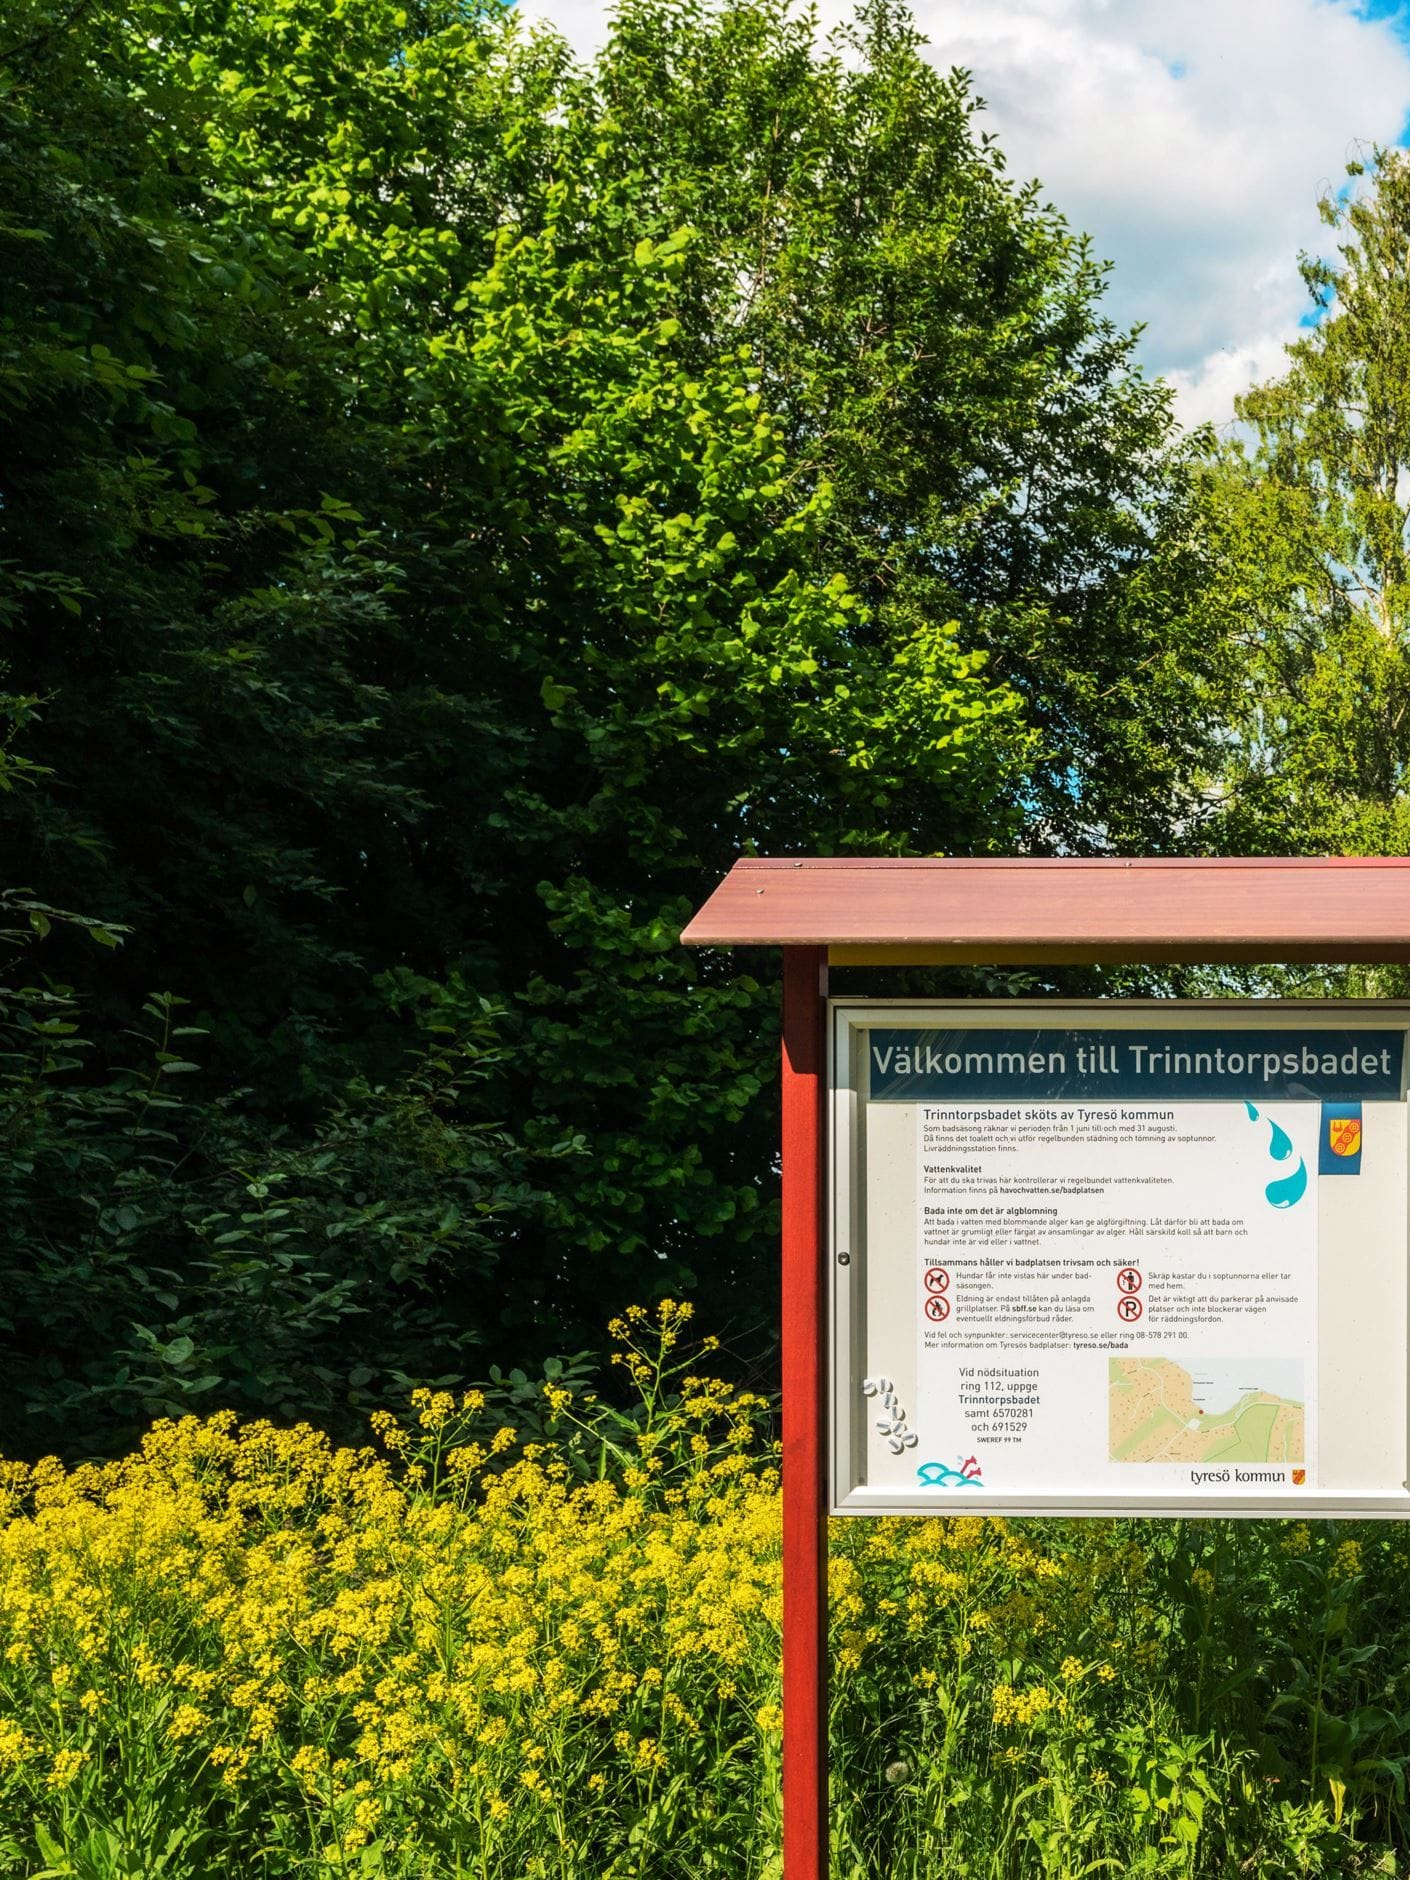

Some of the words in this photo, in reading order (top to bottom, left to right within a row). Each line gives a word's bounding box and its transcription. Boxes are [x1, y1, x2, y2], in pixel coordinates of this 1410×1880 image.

[872, 1046, 1066, 1074] Välkommen
[1077, 1046, 1119, 1074] till
[1129, 1046, 1392, 1082] Trinntorpsbadet
[923, 1109, 1021, 1122] Trinntorpsbadet
[1025, 1109, 1057, 1119] sköts
[1078, 1109, 1117, 1122] Tyresö
[1121, 1109, 1174, 1119] kommun
[1018, 1125, 1051, 1133] perioden
[1076, 1125, 1090, 1133] juni
[1038, 1135, 1085, 1143] regelbunden
[1067, 1177, 1112, 1185] regelbundet
[999, 1187, 1104, 1195] havochvatten.se/badplatsen
[1006, 1207, 1058, 1216] algblomning
[1049, 1218, 1068, 1227] alger
[961, 1228, 993, 1237] grumligt
[1048, 1228, 1094, 1237] ansamlingar
[979, 1258, 1004, 1266] håller
[1015, 1259, 1061, 1268] badplatsen
[1213, 1272, 1260, 1281] soptunnorna
[956, 1295, 984, 1304] Eldning
[1061, 1295, 1091, 1304] anlagda
[1173, 1295, 1196, 1304] viktigt
[1220, 1295, 1252, 1304] parkerar
[1148, 1305, 1174, 1314] platser
[1119, 1331, 1135, 1340] ring
[1073, 1341, 1129, 1350] tyreso.se/bada
[959, 1367, 975, 1376] Vid
[977, 1367, 1040, 1376] nödsituation
[960, 1381, 981, 1392] ring
[985, 1381, 1004, 1391] 112,
[1007, 1384, 1038, 1392] uppge
[959, 1395, 1040, 1407] Trinntorpsbadet
[964, 1408, 989, 1417] samt
[993, 1408, 1034, 1417] 6570281
[971, 1422, 989, 1431] och
[992, 1422, 1028, 1431] 691529
[1191, 1469, 1230, 1485] tyresö
[1235, 1469, 1285, 1482] kommun
